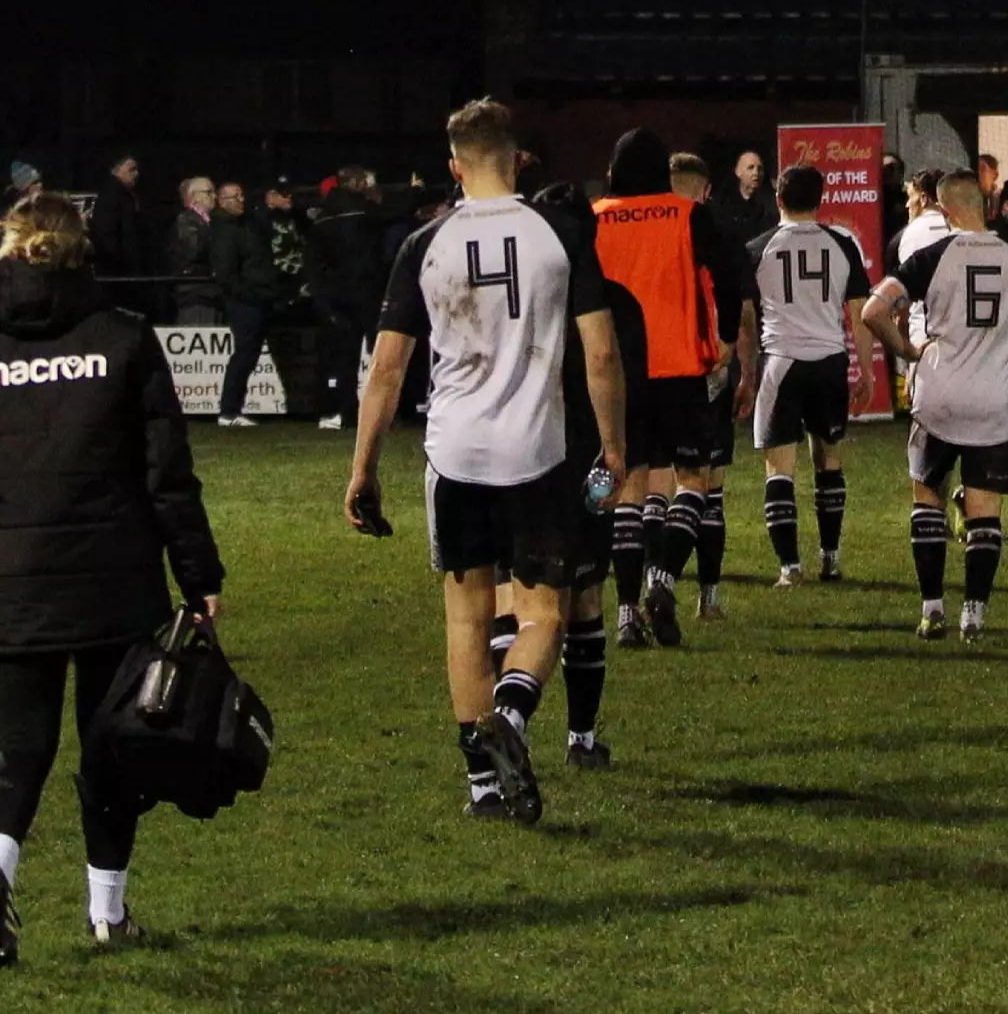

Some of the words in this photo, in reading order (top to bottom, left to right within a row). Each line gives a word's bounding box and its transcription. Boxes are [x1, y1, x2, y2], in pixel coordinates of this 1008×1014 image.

[793, 138, 821, 165] The
[826, 140, 872, 162] Robins
[826, 171, 843, 185] OF
[844, 170, 868, 184] THE
[832, 189, 878, 204] AWARD
[597, 205, 680, 224] macron
[466, 236, 520, 320] 4
[776, 249, 830, 304] 14
[965, 265, 1002, 328] 6
[166, 332, 232, 355] CAM
